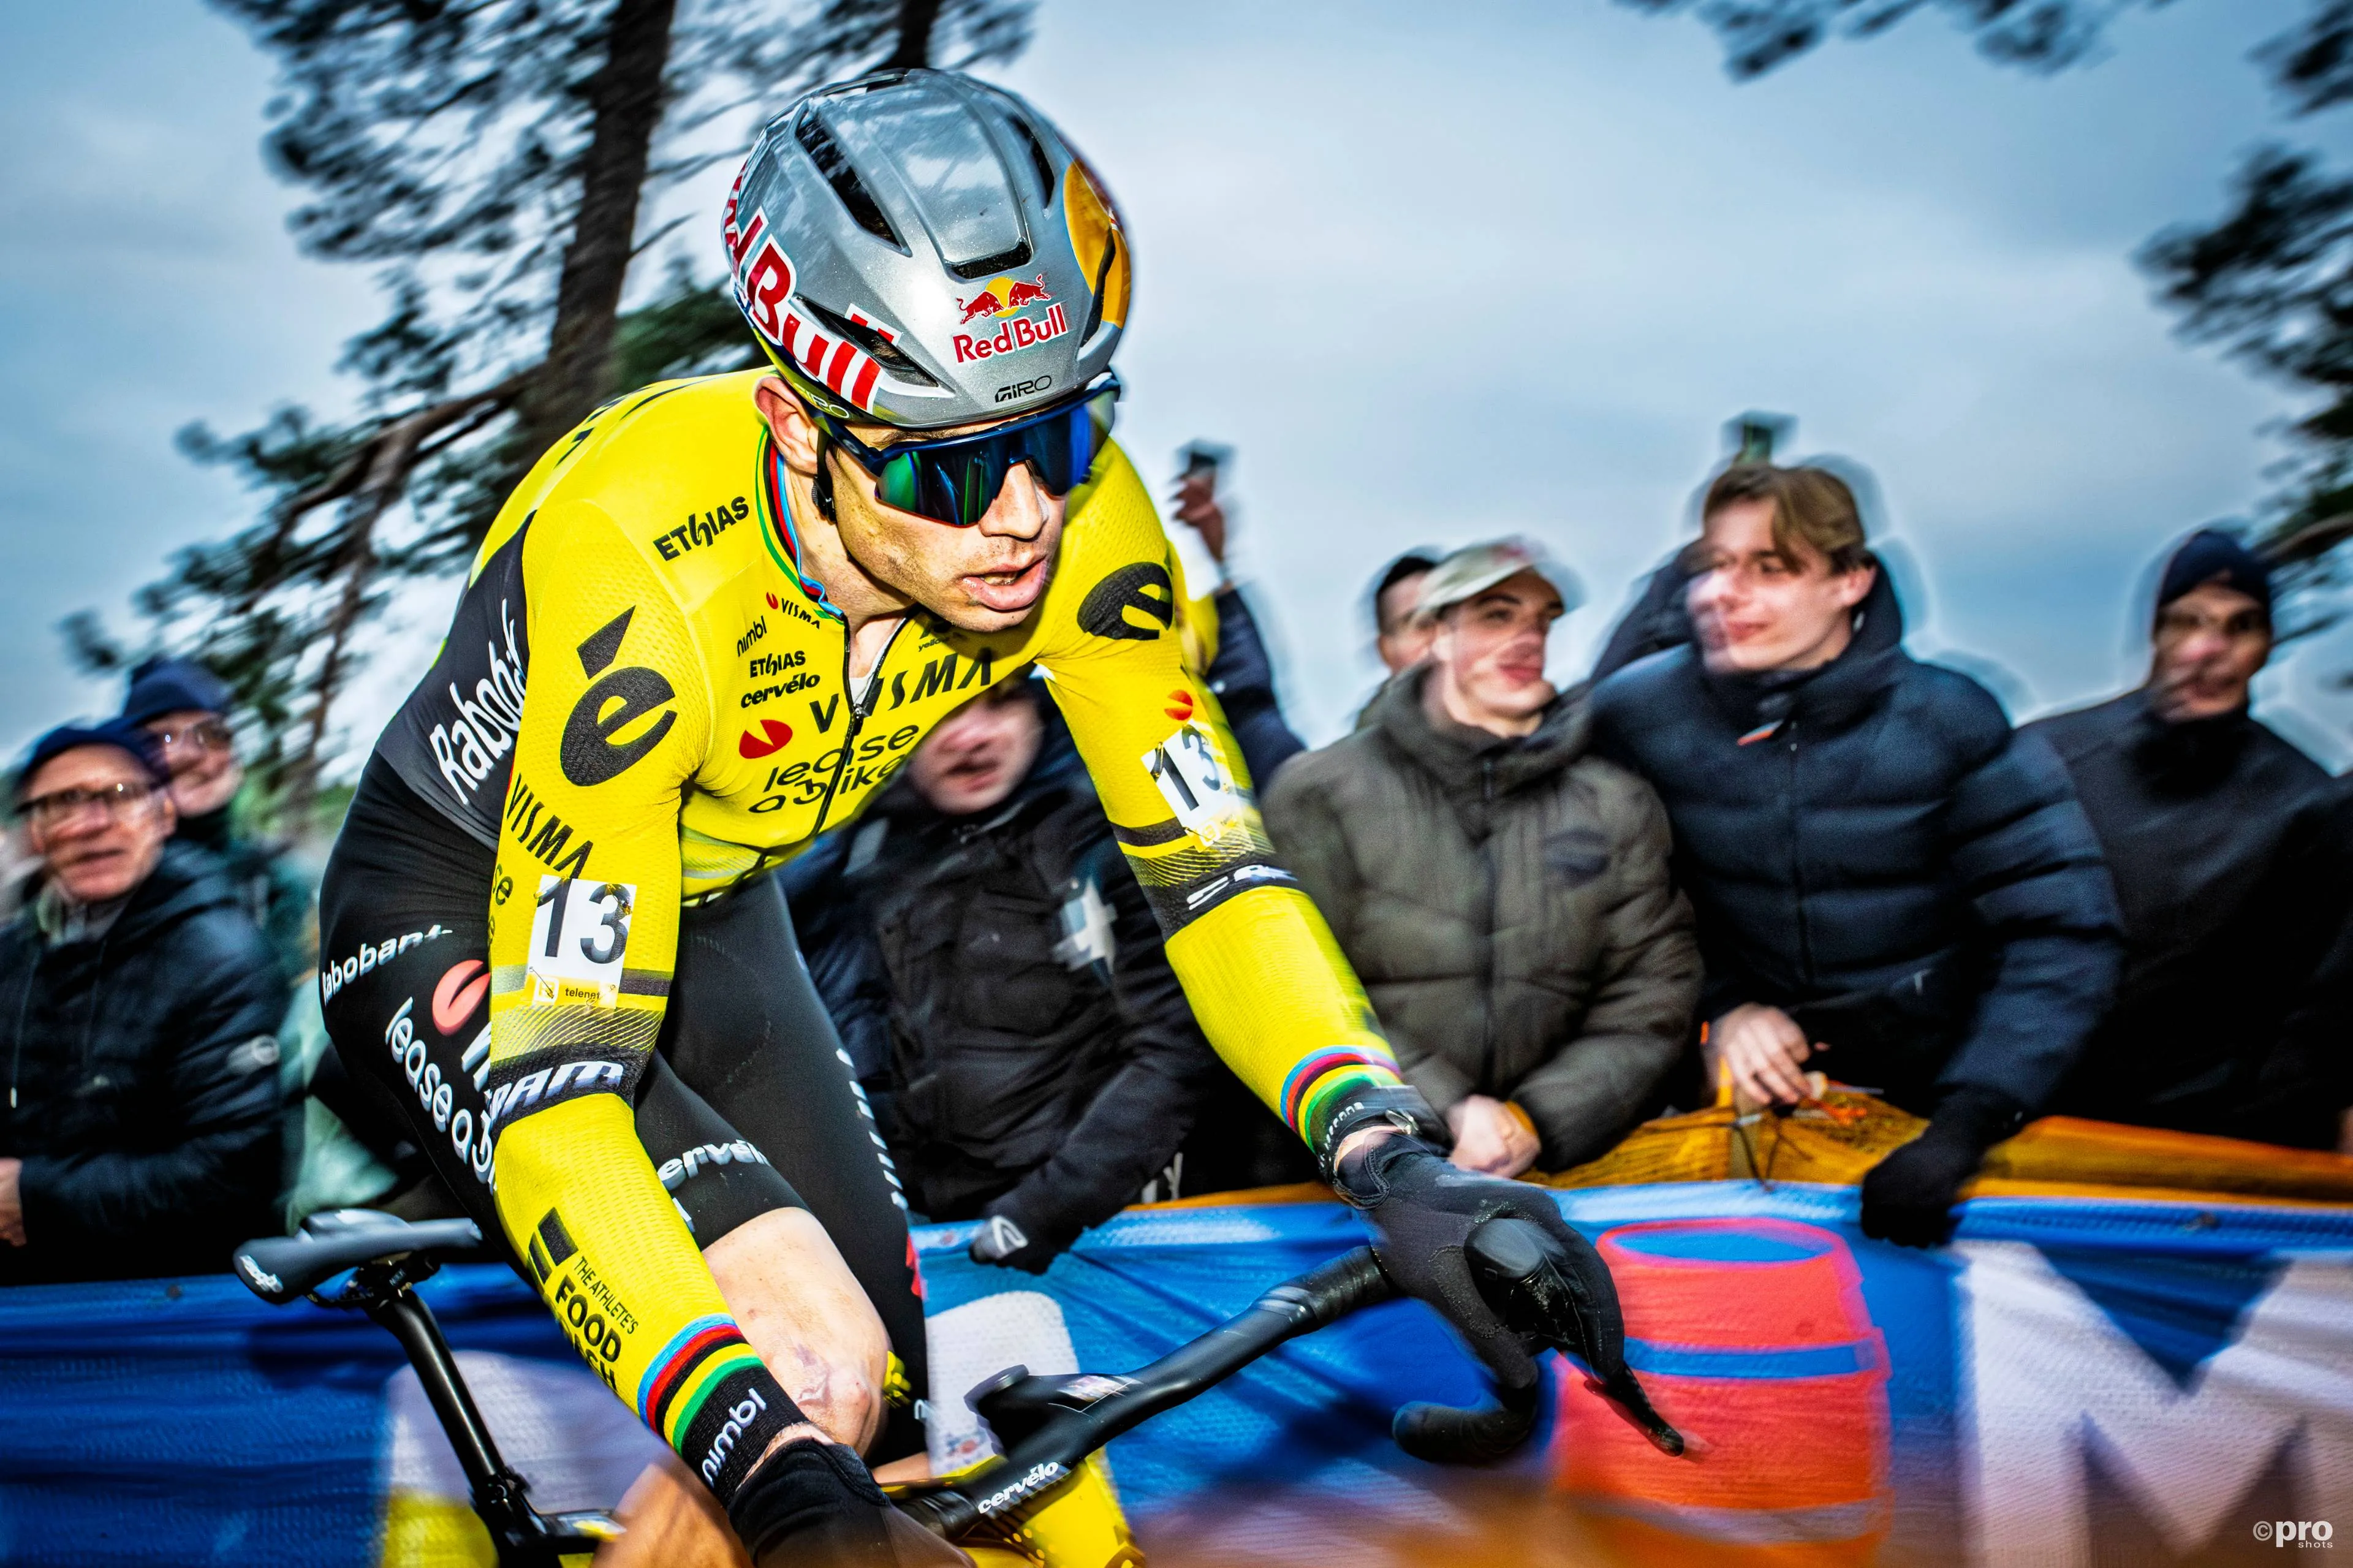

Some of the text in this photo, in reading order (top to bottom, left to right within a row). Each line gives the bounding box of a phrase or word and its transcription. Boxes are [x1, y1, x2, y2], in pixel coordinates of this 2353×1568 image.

[953, 304, 1067, 363] Red Bull
[995, 375, 1052, 403] GIRO
[737, 615, 768, 657] nimbl
[781, 598, 821, 630] VISMA
[430, 598, 527, 805] Rabob
[740, 672, 821, 709] cervélo
[809, 647, 992, 734] VISMA
[763, 725, 919, 793] lease
[1142, 724, 1221, 811] 13
[507, 773, 594, 879] VISMA
[537, 879, 632, 964] 13
[564, 988, 601, 1000] telenet
[385, 996, 453, 1132] lease
[657, 1138, 771, 1191] ervél
[555, 1274, 621, 1363] FOOD
[574, 1256, 639, 1335] THE ATHLETE'S
[702, 1387, 767, 1489] nimbl
[977, 1461, 1059, 1514] cervélo
